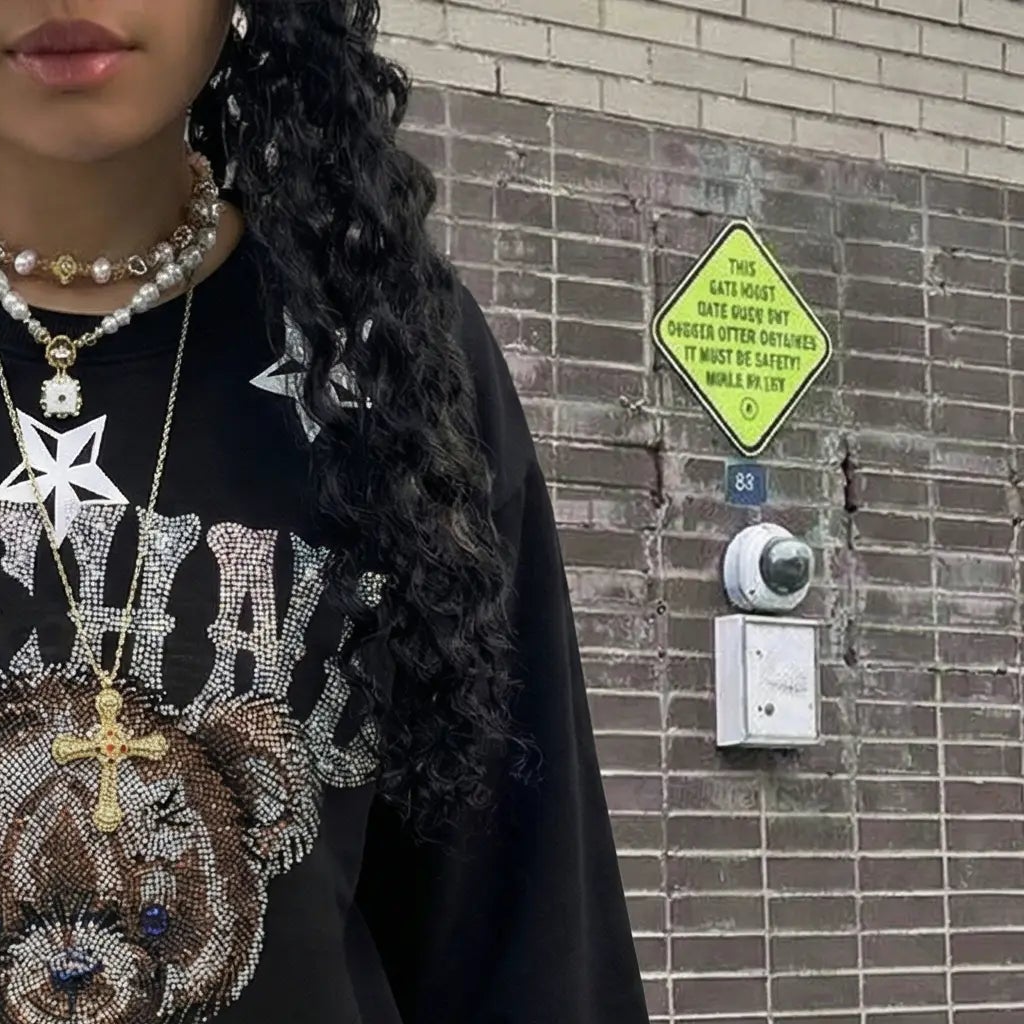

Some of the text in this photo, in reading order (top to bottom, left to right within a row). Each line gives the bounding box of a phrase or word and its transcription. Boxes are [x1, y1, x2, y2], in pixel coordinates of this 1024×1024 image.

[728, 258, 756, 277] THIS
[699, 346, 734, 365] MUST
[735, 471, 755, 492] 83
